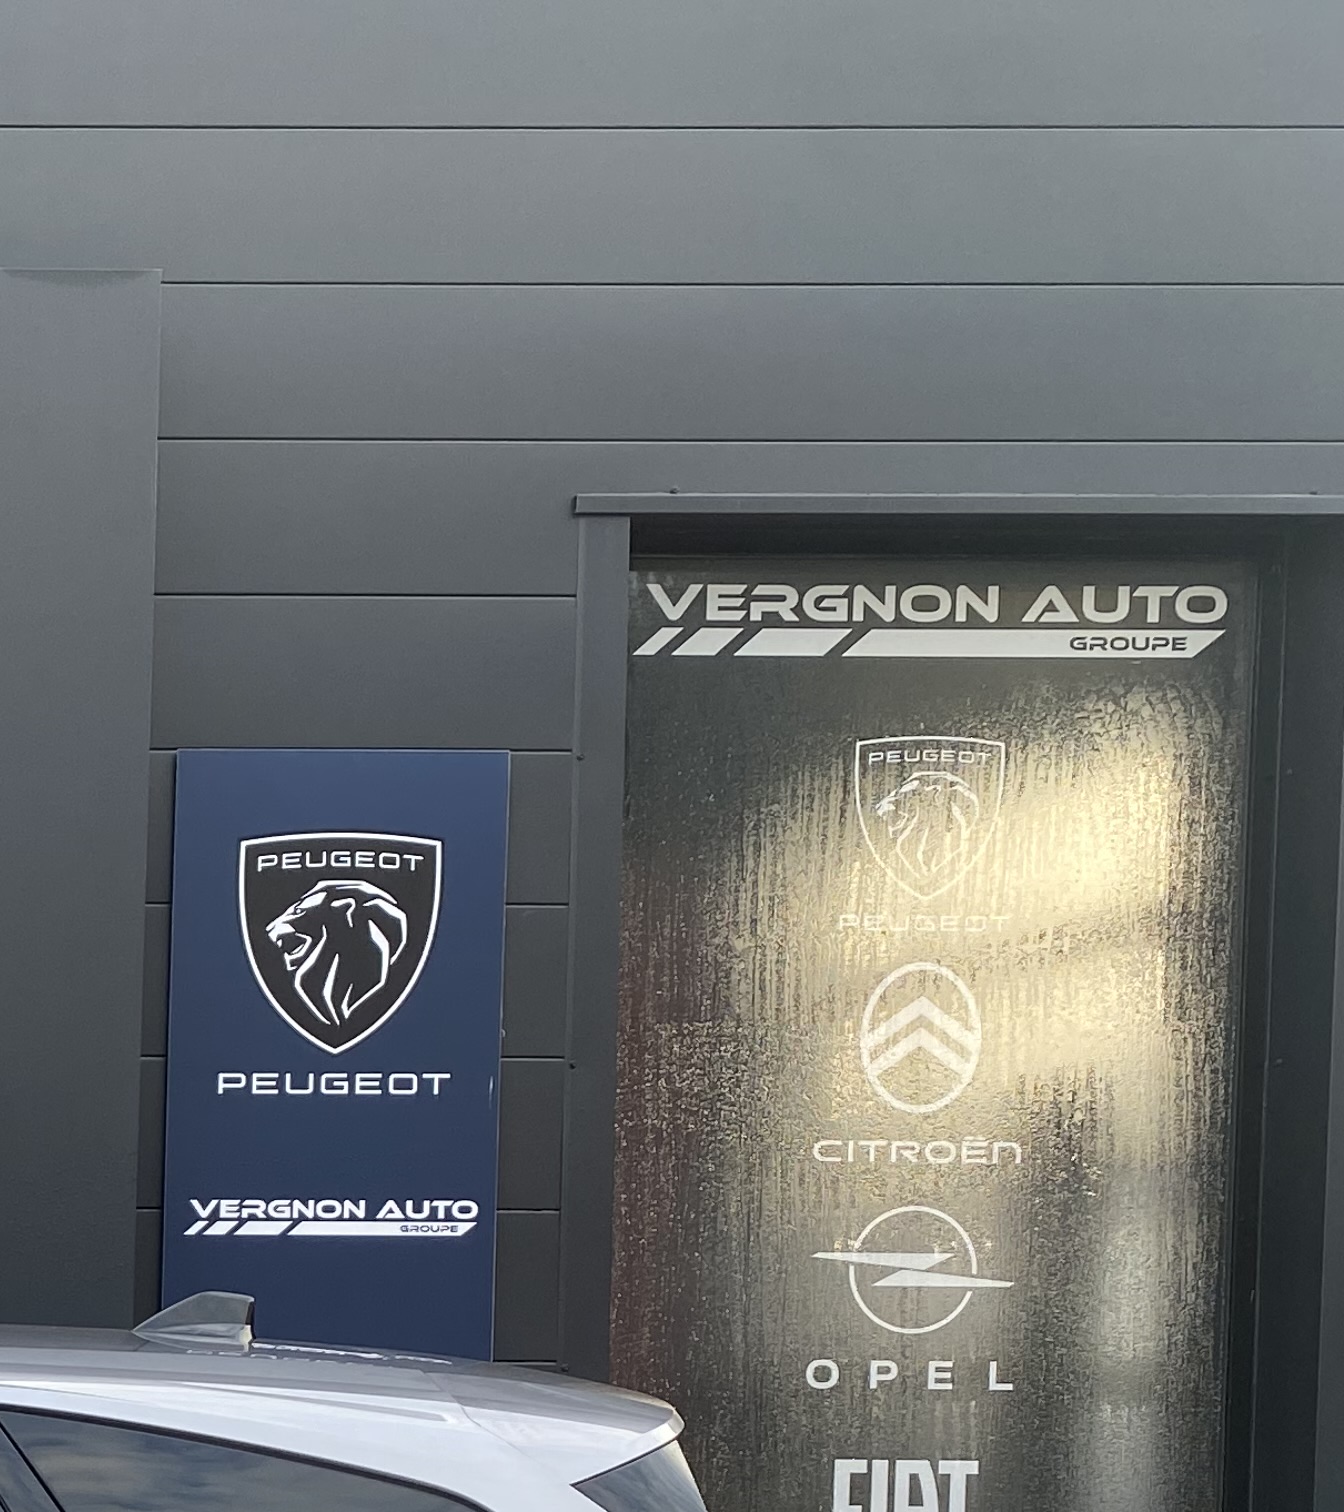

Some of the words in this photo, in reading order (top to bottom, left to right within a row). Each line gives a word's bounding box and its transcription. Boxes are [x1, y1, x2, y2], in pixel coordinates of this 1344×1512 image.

[645, 582, 999, 623] VERGNON
[1021, 584, 1229, 625] AUTO
[1069, 636, 1188, 652] GROUPE
[868, 748, 992, 765] PEUGEOT
[257, 850, 425, 872] PEUGEOT
[839, 913, 1011, 932] PEUGEOT
[217, 1072, 451, 1095] PEUGEOT
[189, 1199, 367, 1219] VERGNON
[376, 1201, 479, 1220] AUTO
[400, 1224, 459, 1234] GROUPE
[805, 1360, 1014, 1391] OPEL
